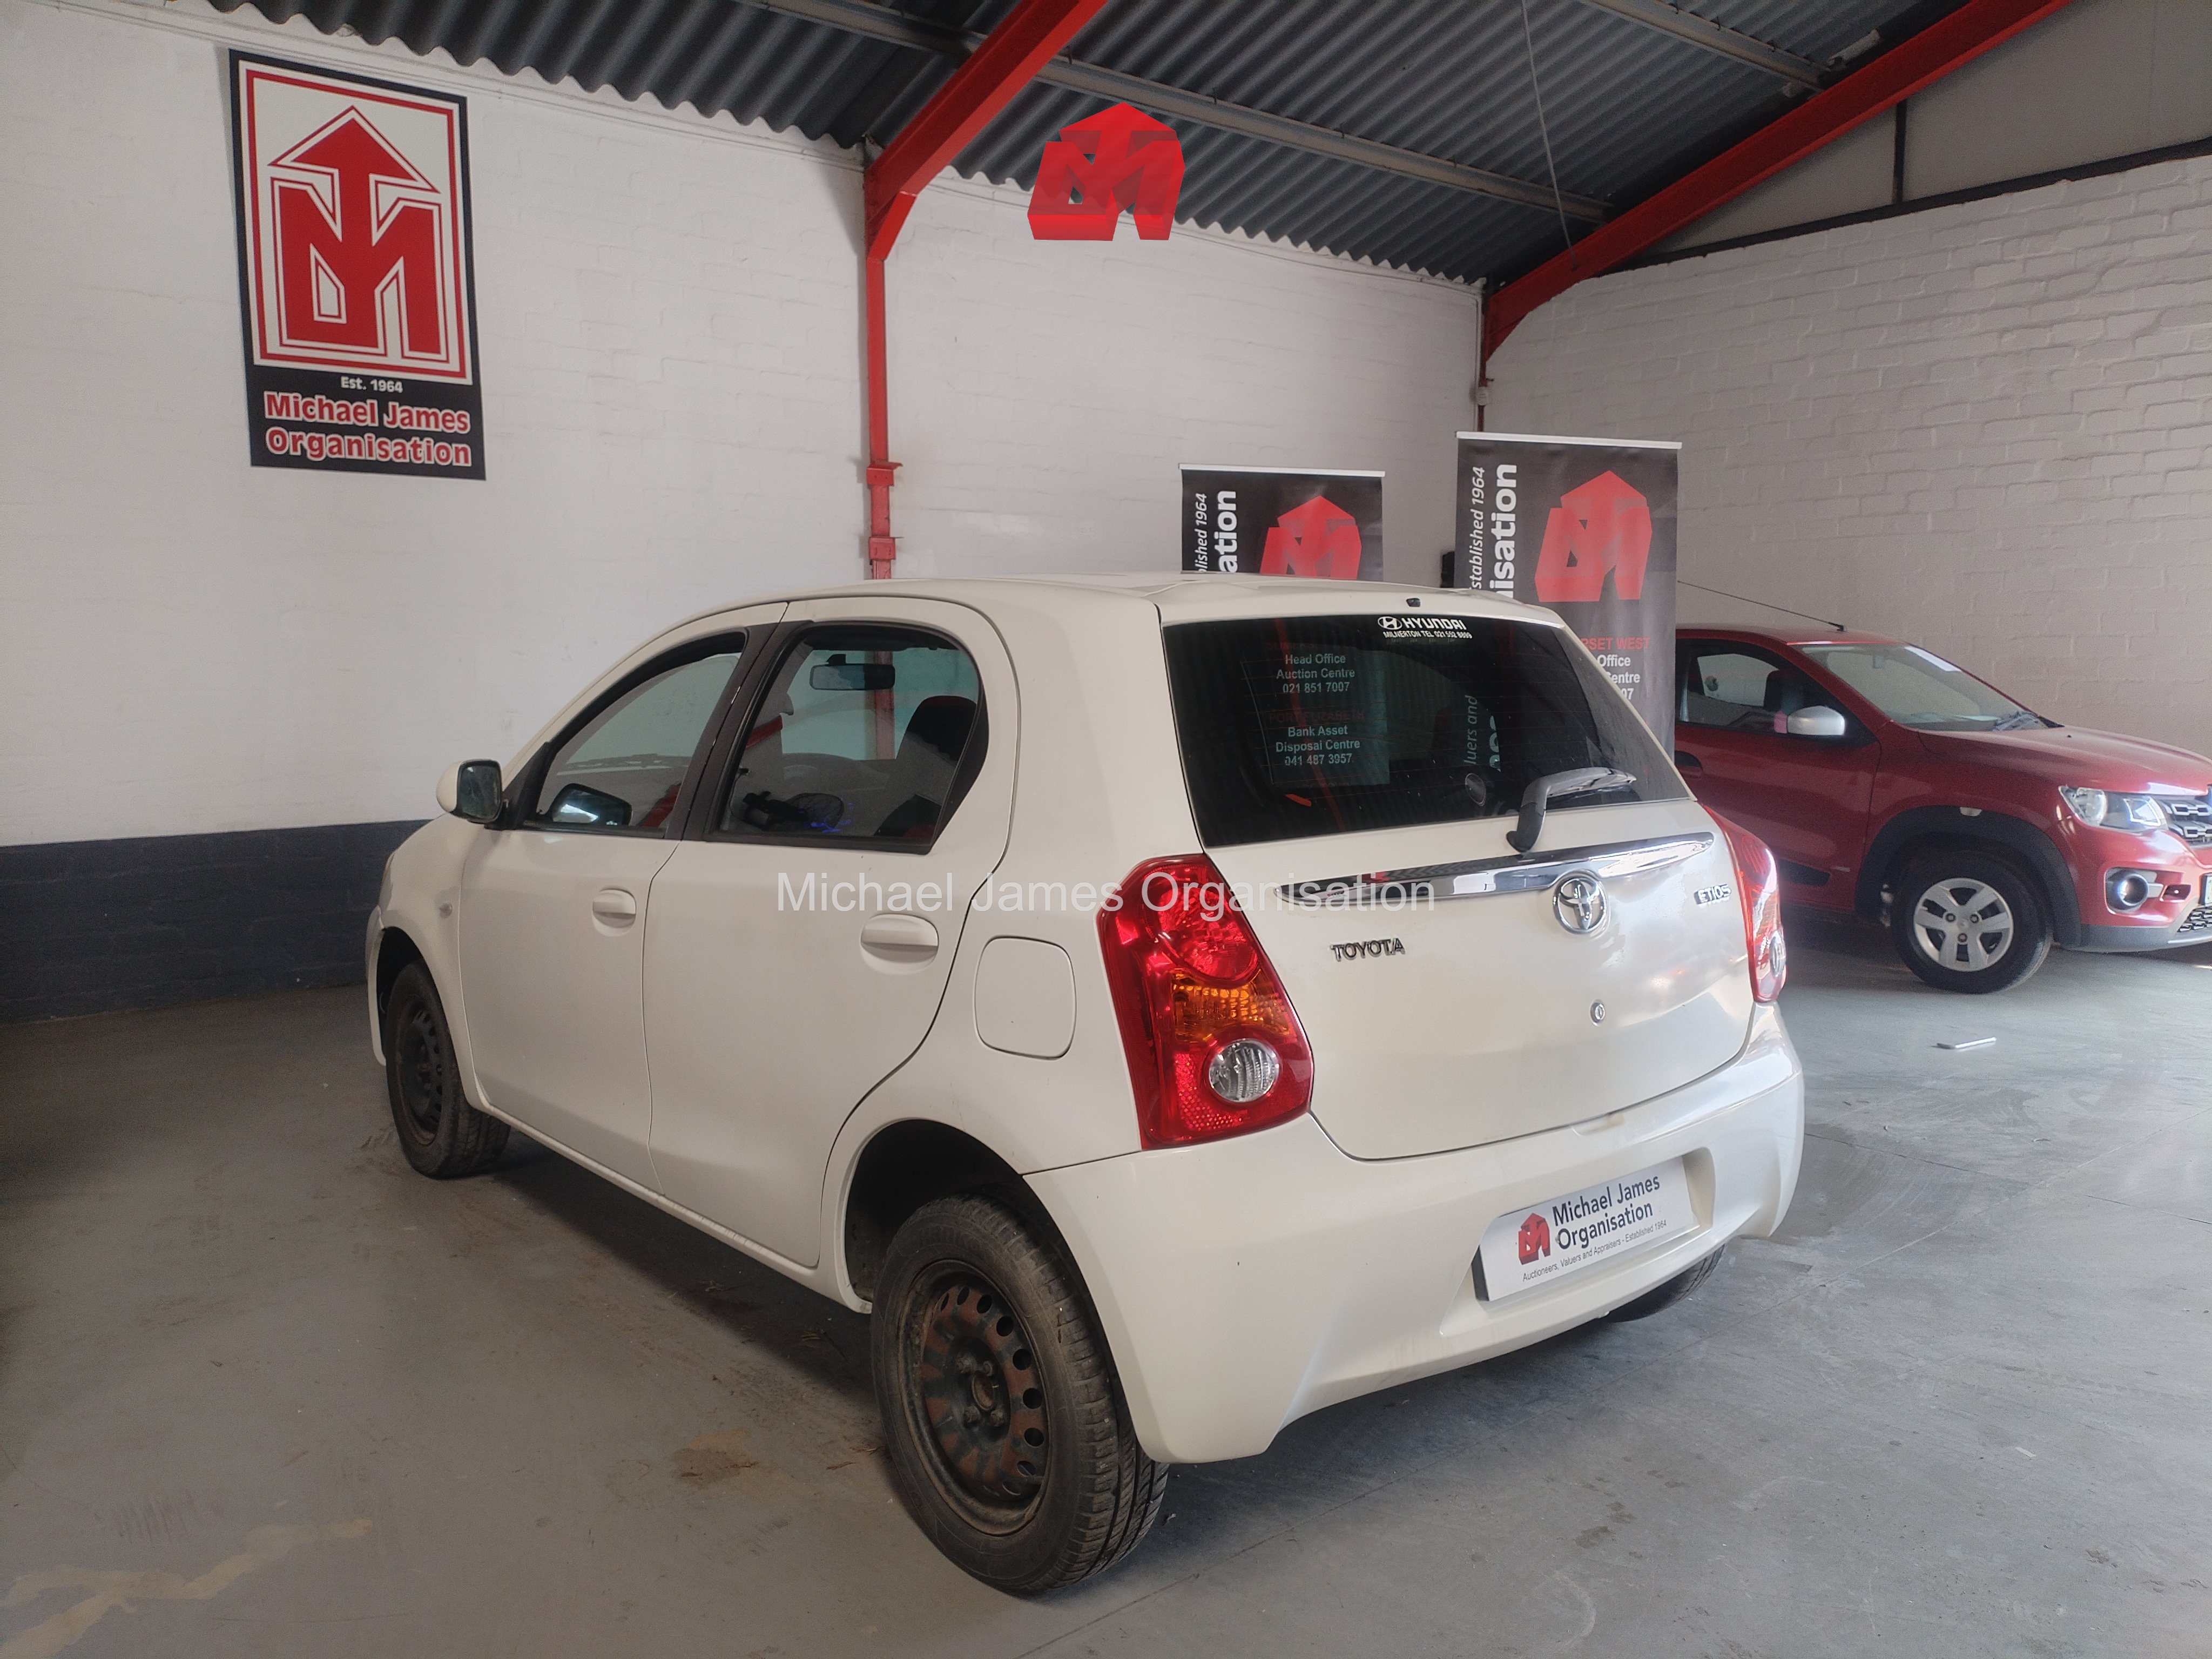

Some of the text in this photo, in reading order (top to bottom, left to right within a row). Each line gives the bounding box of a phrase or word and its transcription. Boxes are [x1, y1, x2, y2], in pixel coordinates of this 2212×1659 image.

[341, 376, 403, 393] Est. 1964
[264, 390, 471, 434] Michael James
[266, 427, 471, 467] Organisation
[1195, 493, 1208, 526] 1964
[1214, 490, 1238, 573] ation
[1468, 466, 1485, 590] stablished 1964
[1401, 617, 1467, 630] HYUNDAI
[1382, 630, 1422, 638] MILNERTON
[1616, 637, 1651, 650] WEST
[1285, 653, 1346, 665] Head Office
[1597, 654, 1631, 667] Office
[1276, 667, 1355, 679] Auction Centre
[1283, 681, 1350, 693] 021 851 7007
[1464, 694, 1478, 725] and
[1287, 725, 1348, 738] Bank Asset
[1325, 739, 1360, 750] Centre
[1306, 754, 1325, 765] 487
[1328, 753, 1352, 764] 3957
[1697, 884, 1731, 903] ETIOS
[1330, 938, 1406, 962] TOYOTA
[1552, 1176, 1660, 1226] Michael James
[1557, 1203, 1653, 1249] Organisation
[1522, 1263, 1559, 1282] Auctioneers,
[1560, 1253, 1582, 1267] Valuers
[1582, 1248, 1593, 1259] and
[1593, 1238, 1621, 1256] Appraisers
[1625, 1225, 1654, 1243] Established
